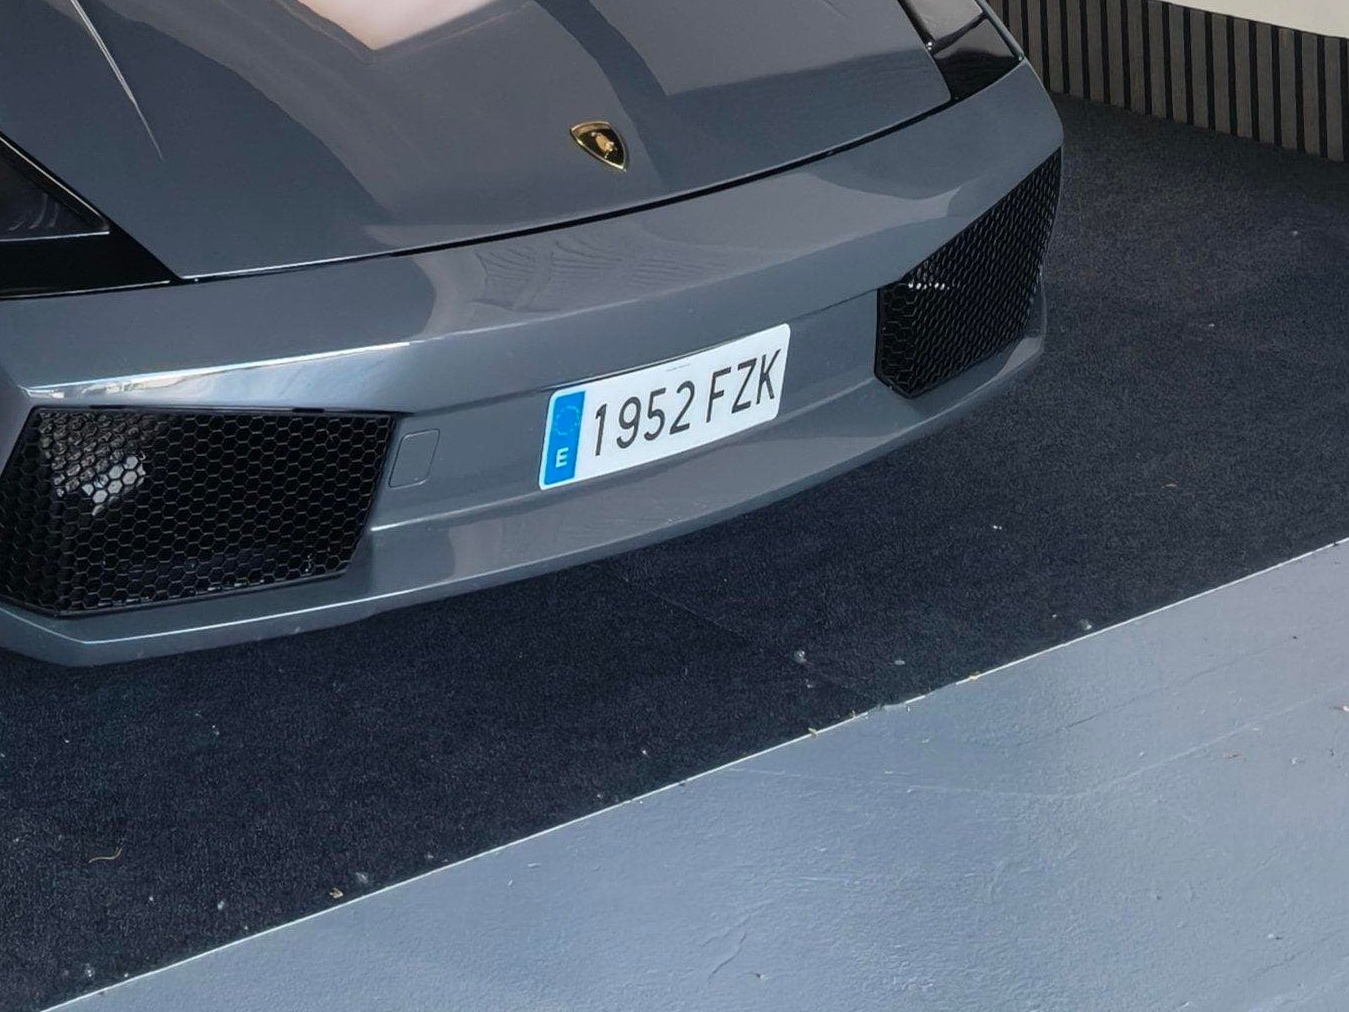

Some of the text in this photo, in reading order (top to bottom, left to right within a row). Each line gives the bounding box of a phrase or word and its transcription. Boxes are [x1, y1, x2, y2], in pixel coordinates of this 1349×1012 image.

[594, 348, 783, 457] 1952 FZK
[554, 446, 570, 468] E
